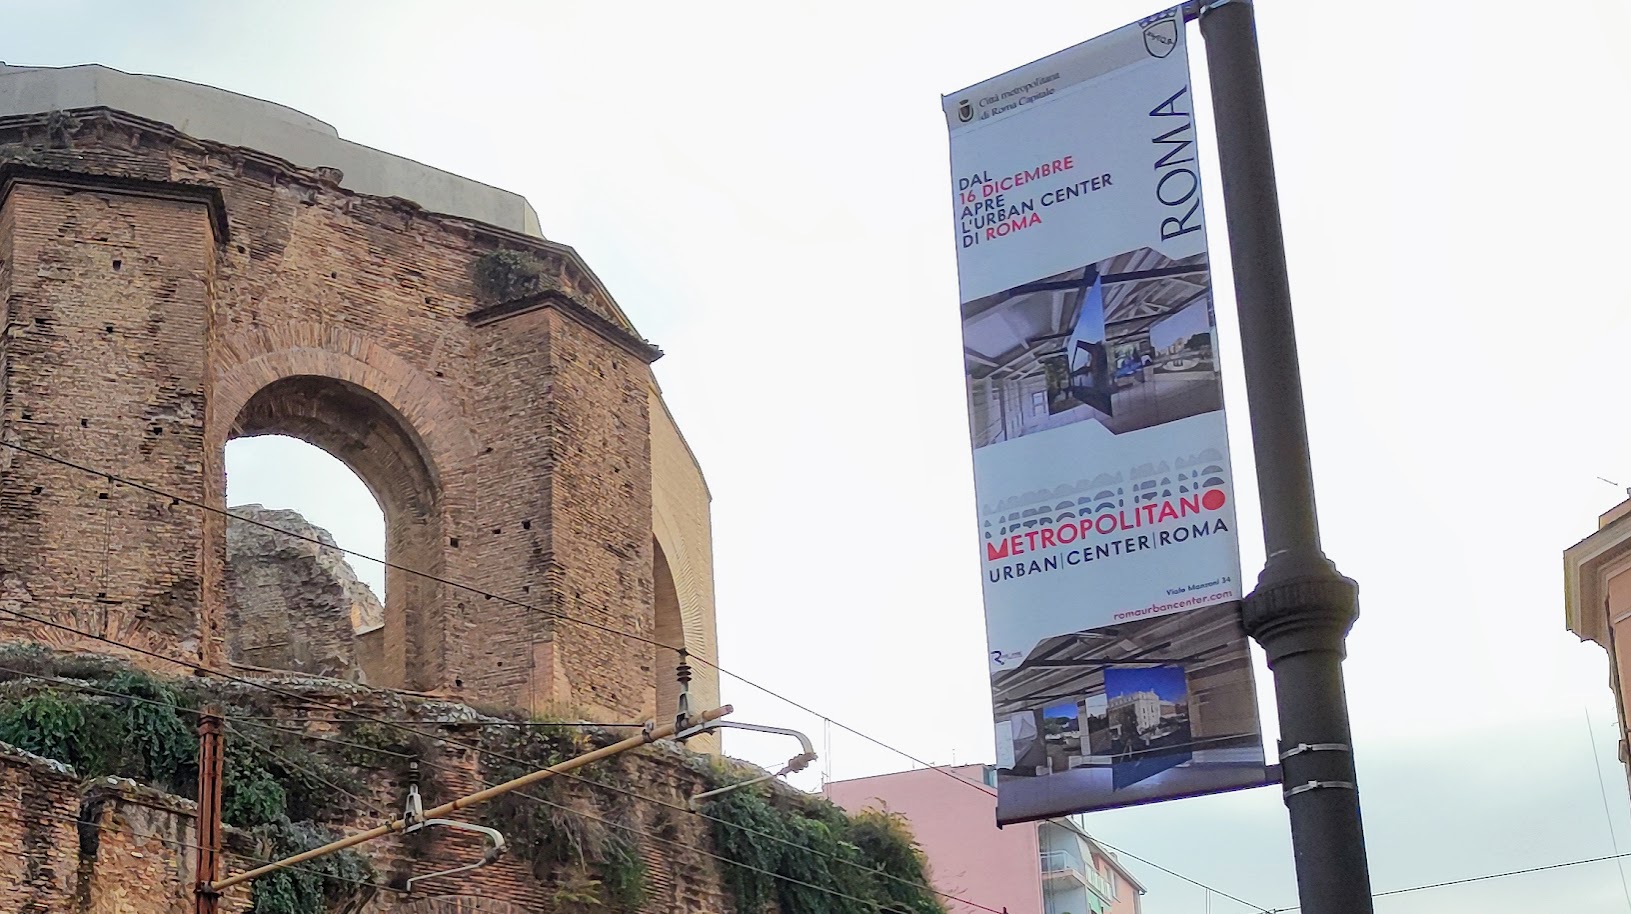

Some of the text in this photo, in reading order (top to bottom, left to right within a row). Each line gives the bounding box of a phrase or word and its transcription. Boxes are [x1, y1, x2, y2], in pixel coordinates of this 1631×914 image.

[1001, 73, 1060, 99] metropolitana
[980, 87, 1056, 120] di Roma Capitale
[1149, 84, 1201, 242] ROMA
[959, 155, 1074, 205] 16 DICEMBRE
[959, 170, 992, 191] DAL
[960, 194, 1005, 220] APRE
[961, 173, 1113, 234] L'URBAN CENTER
[963, 212, 1042, 248] DI ROMA
[987, 489, 1226, 561] METROPOLITANO
[1166, 576, 1231, 596] Viale Manzoni 34
[1113, 590, 1233, 620] romaurbancenter.com
